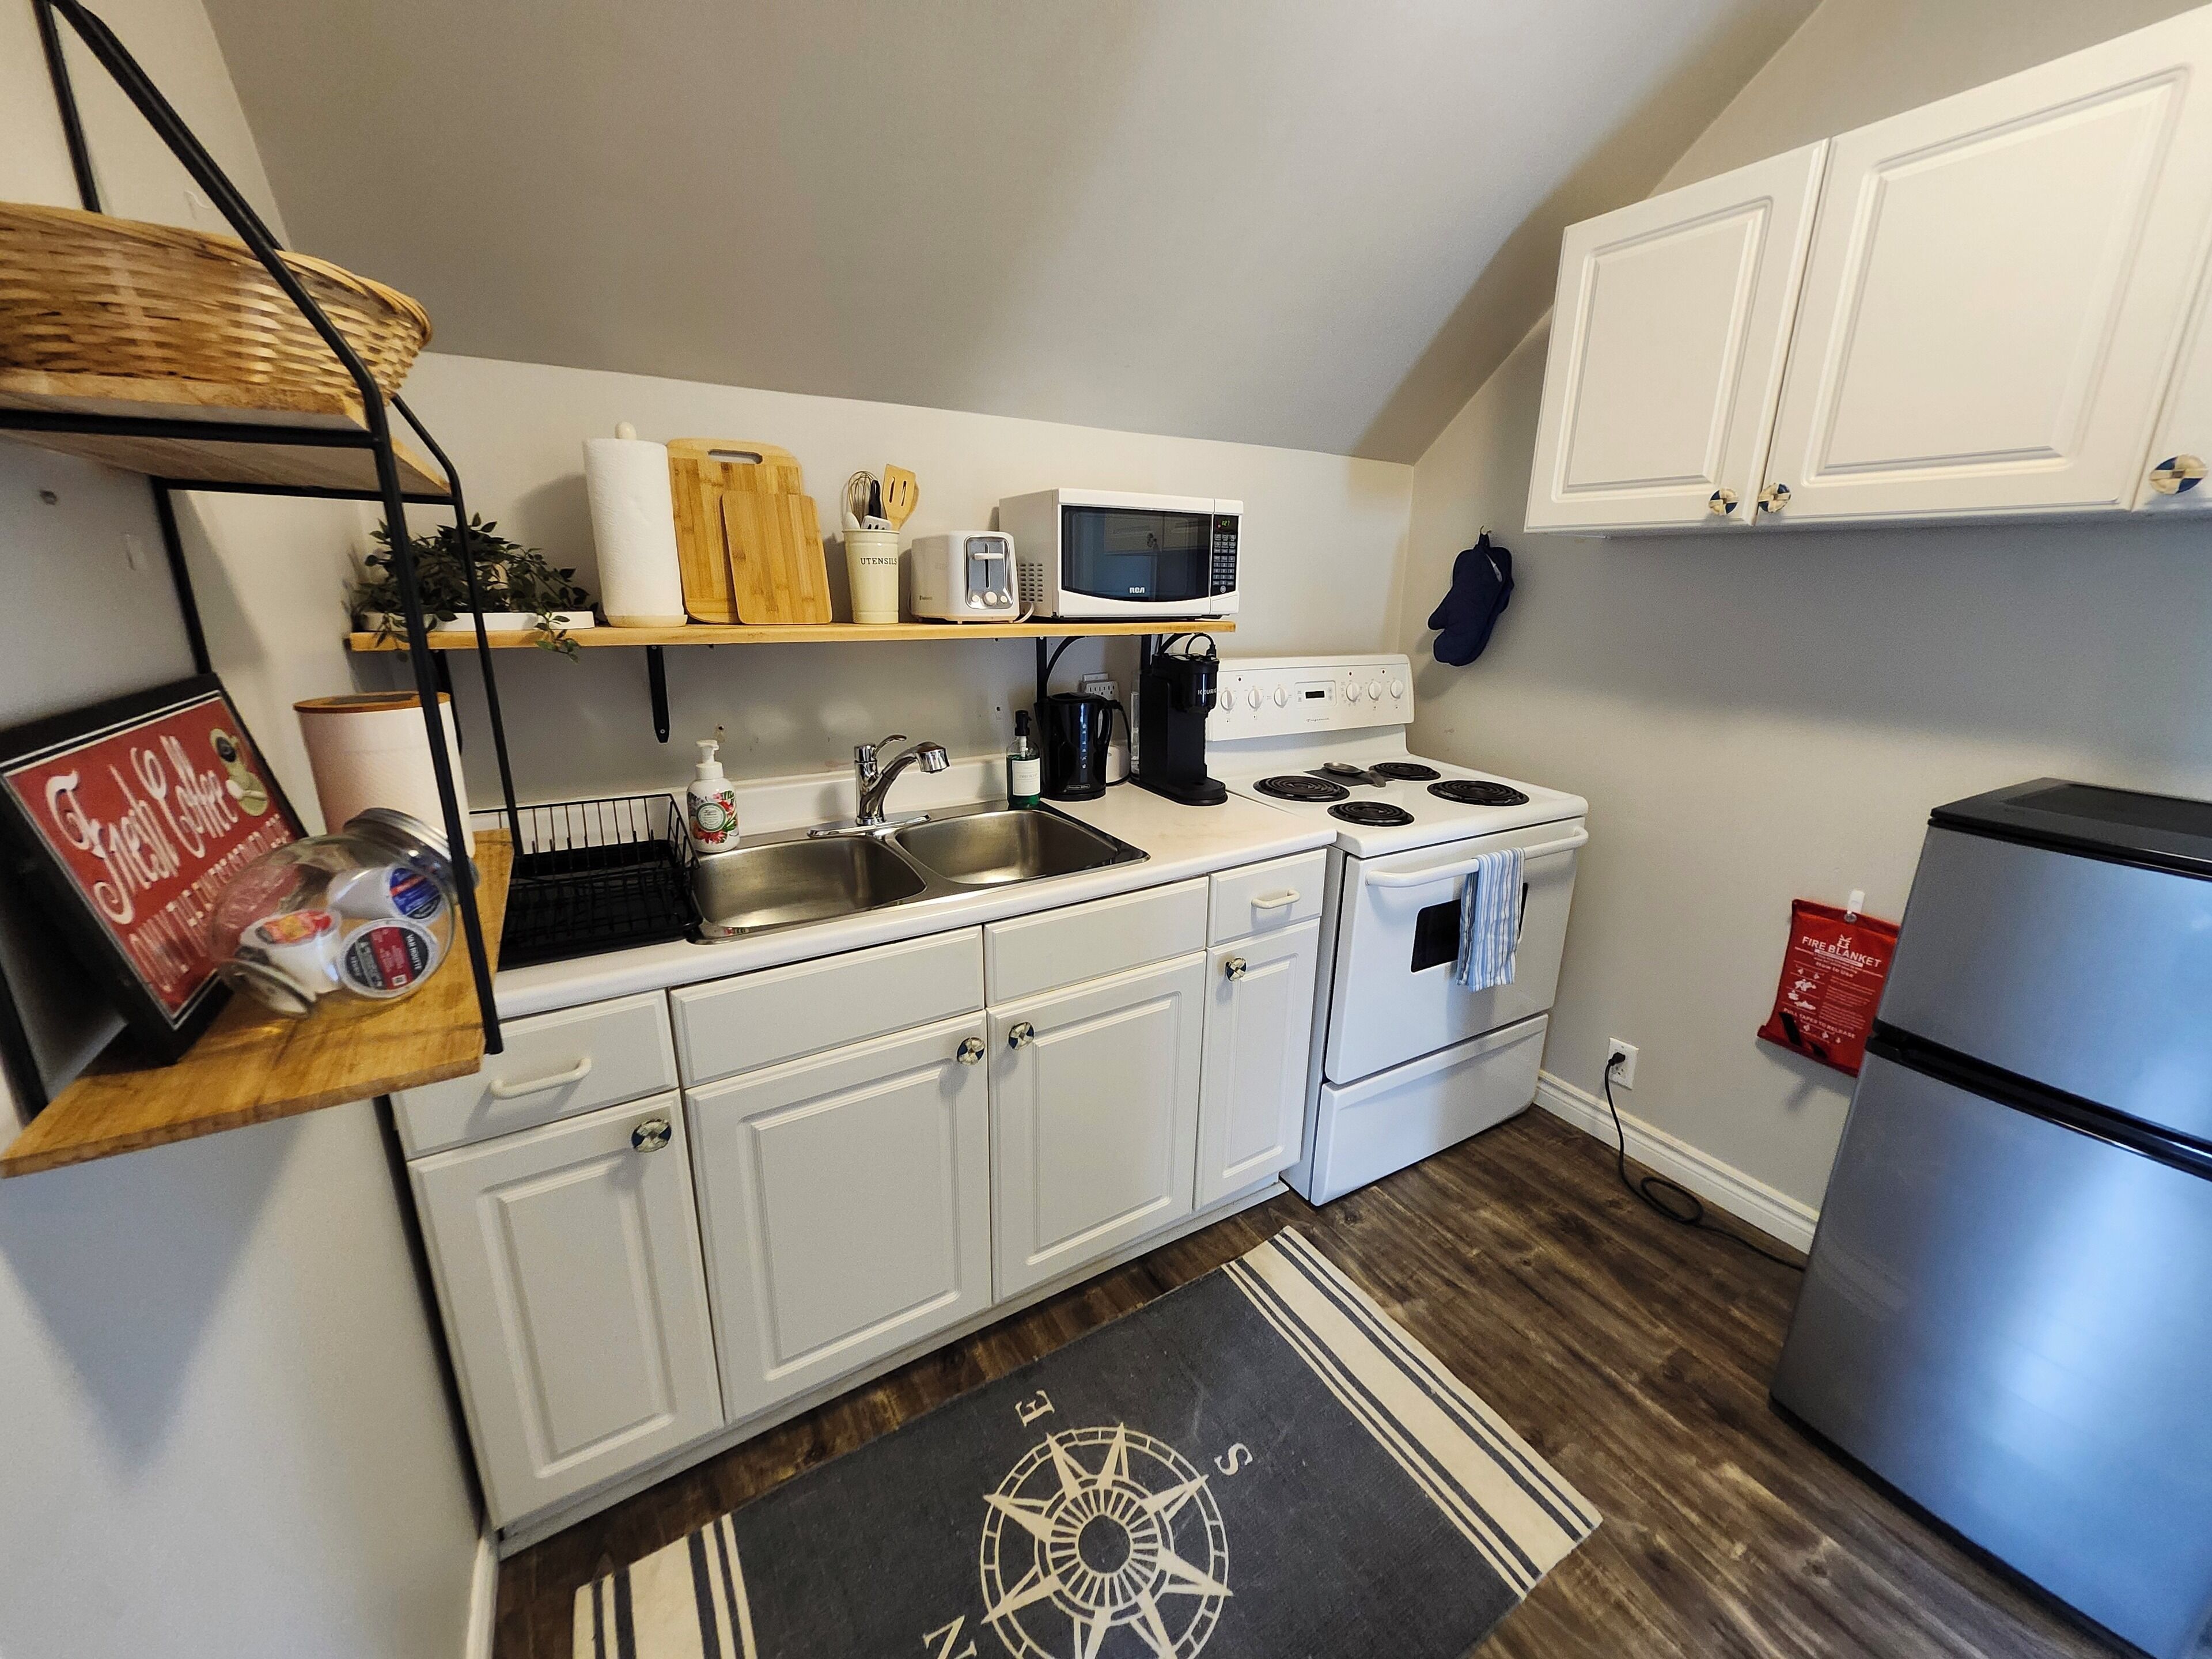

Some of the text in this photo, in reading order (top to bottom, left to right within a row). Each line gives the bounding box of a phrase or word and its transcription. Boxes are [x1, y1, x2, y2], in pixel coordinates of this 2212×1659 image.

[46, 736, 238, 925] Fresh Coffee
[1802, 936, 1827, 950] FIRE
[1827, 945, 1882, 968] BLANKET
[1827, 1025, 1855, 1039] RELEASE
[1014, 1389, 1055, 1427] E
[1214, 1442, 1253, 1476] S
